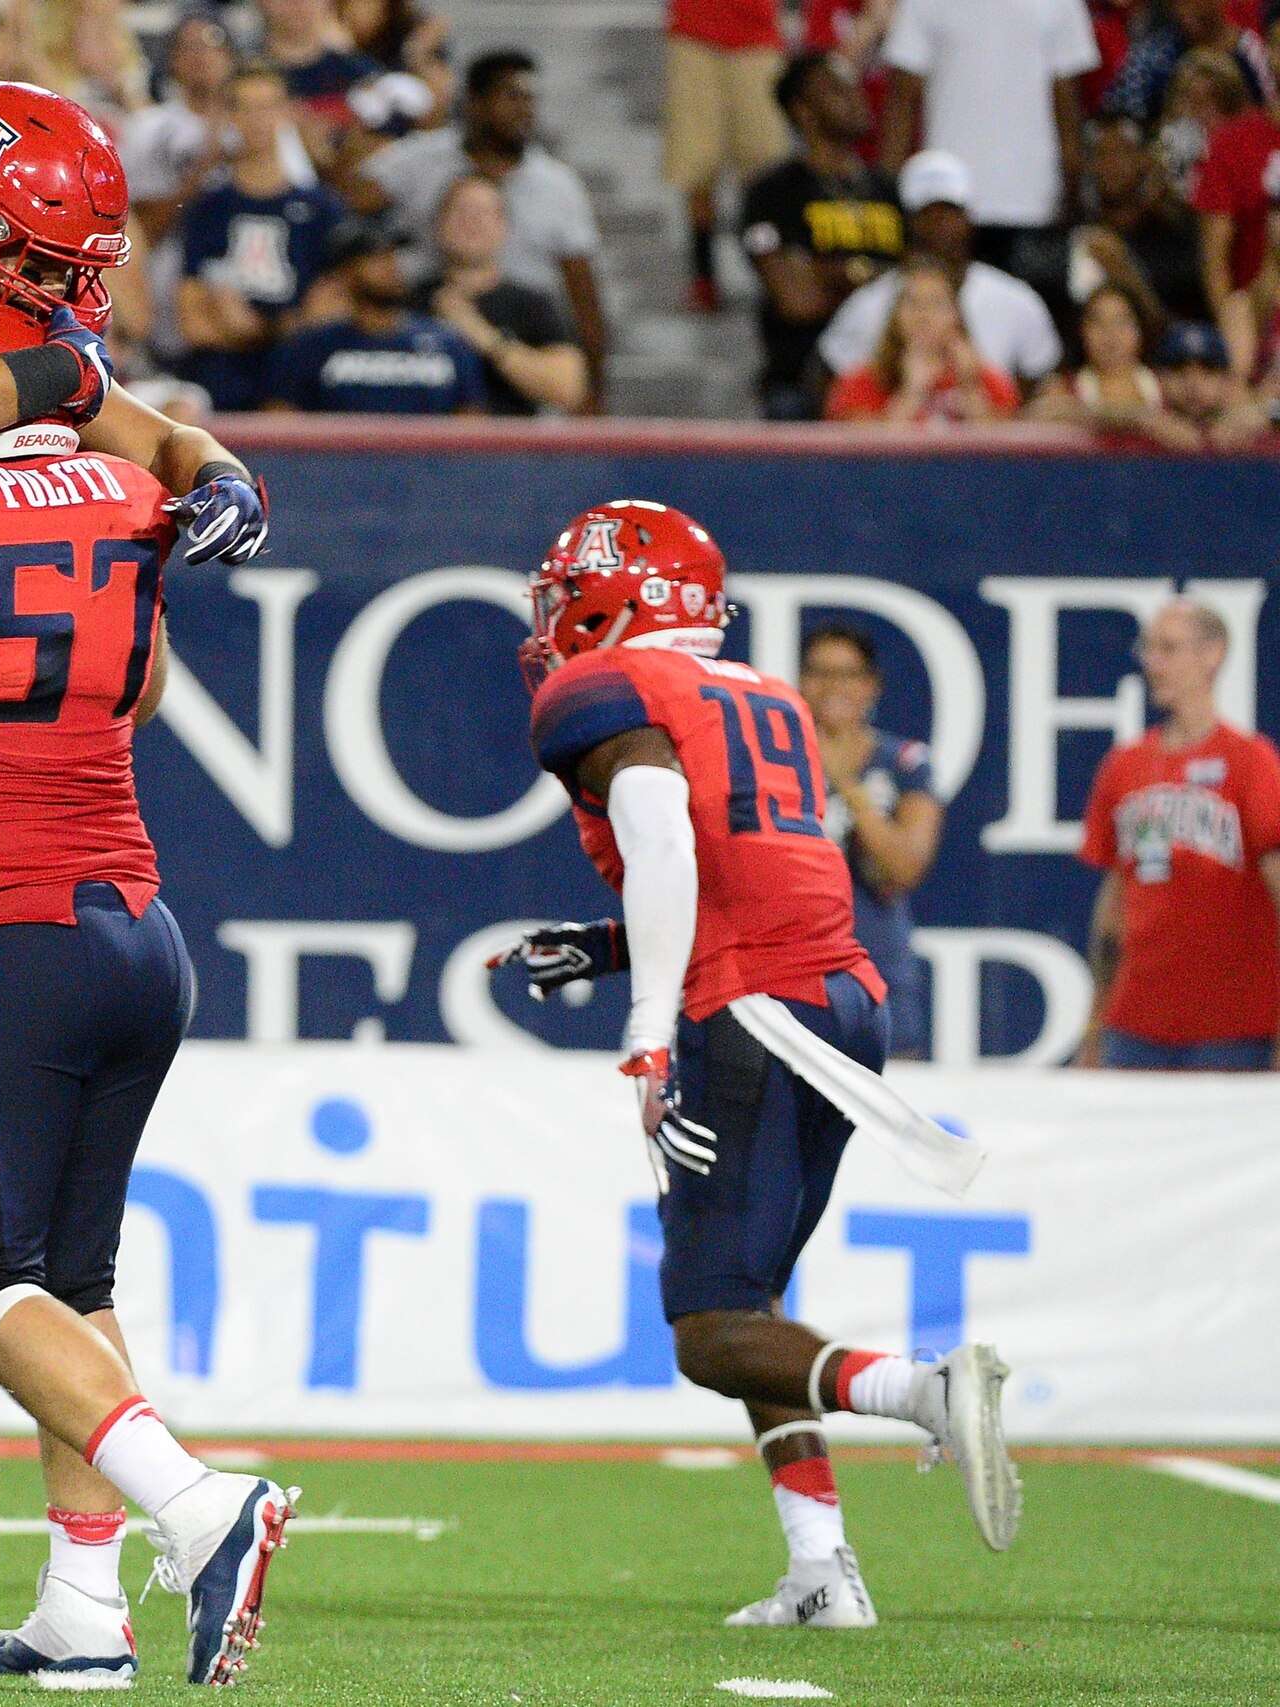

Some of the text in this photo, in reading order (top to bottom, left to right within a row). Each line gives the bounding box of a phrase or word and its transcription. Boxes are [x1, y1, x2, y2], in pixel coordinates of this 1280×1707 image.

[568, 518, 625, 576] A
[699, 684, 825, 836] 19
[797, 1585, 829, 1623] NIKE
